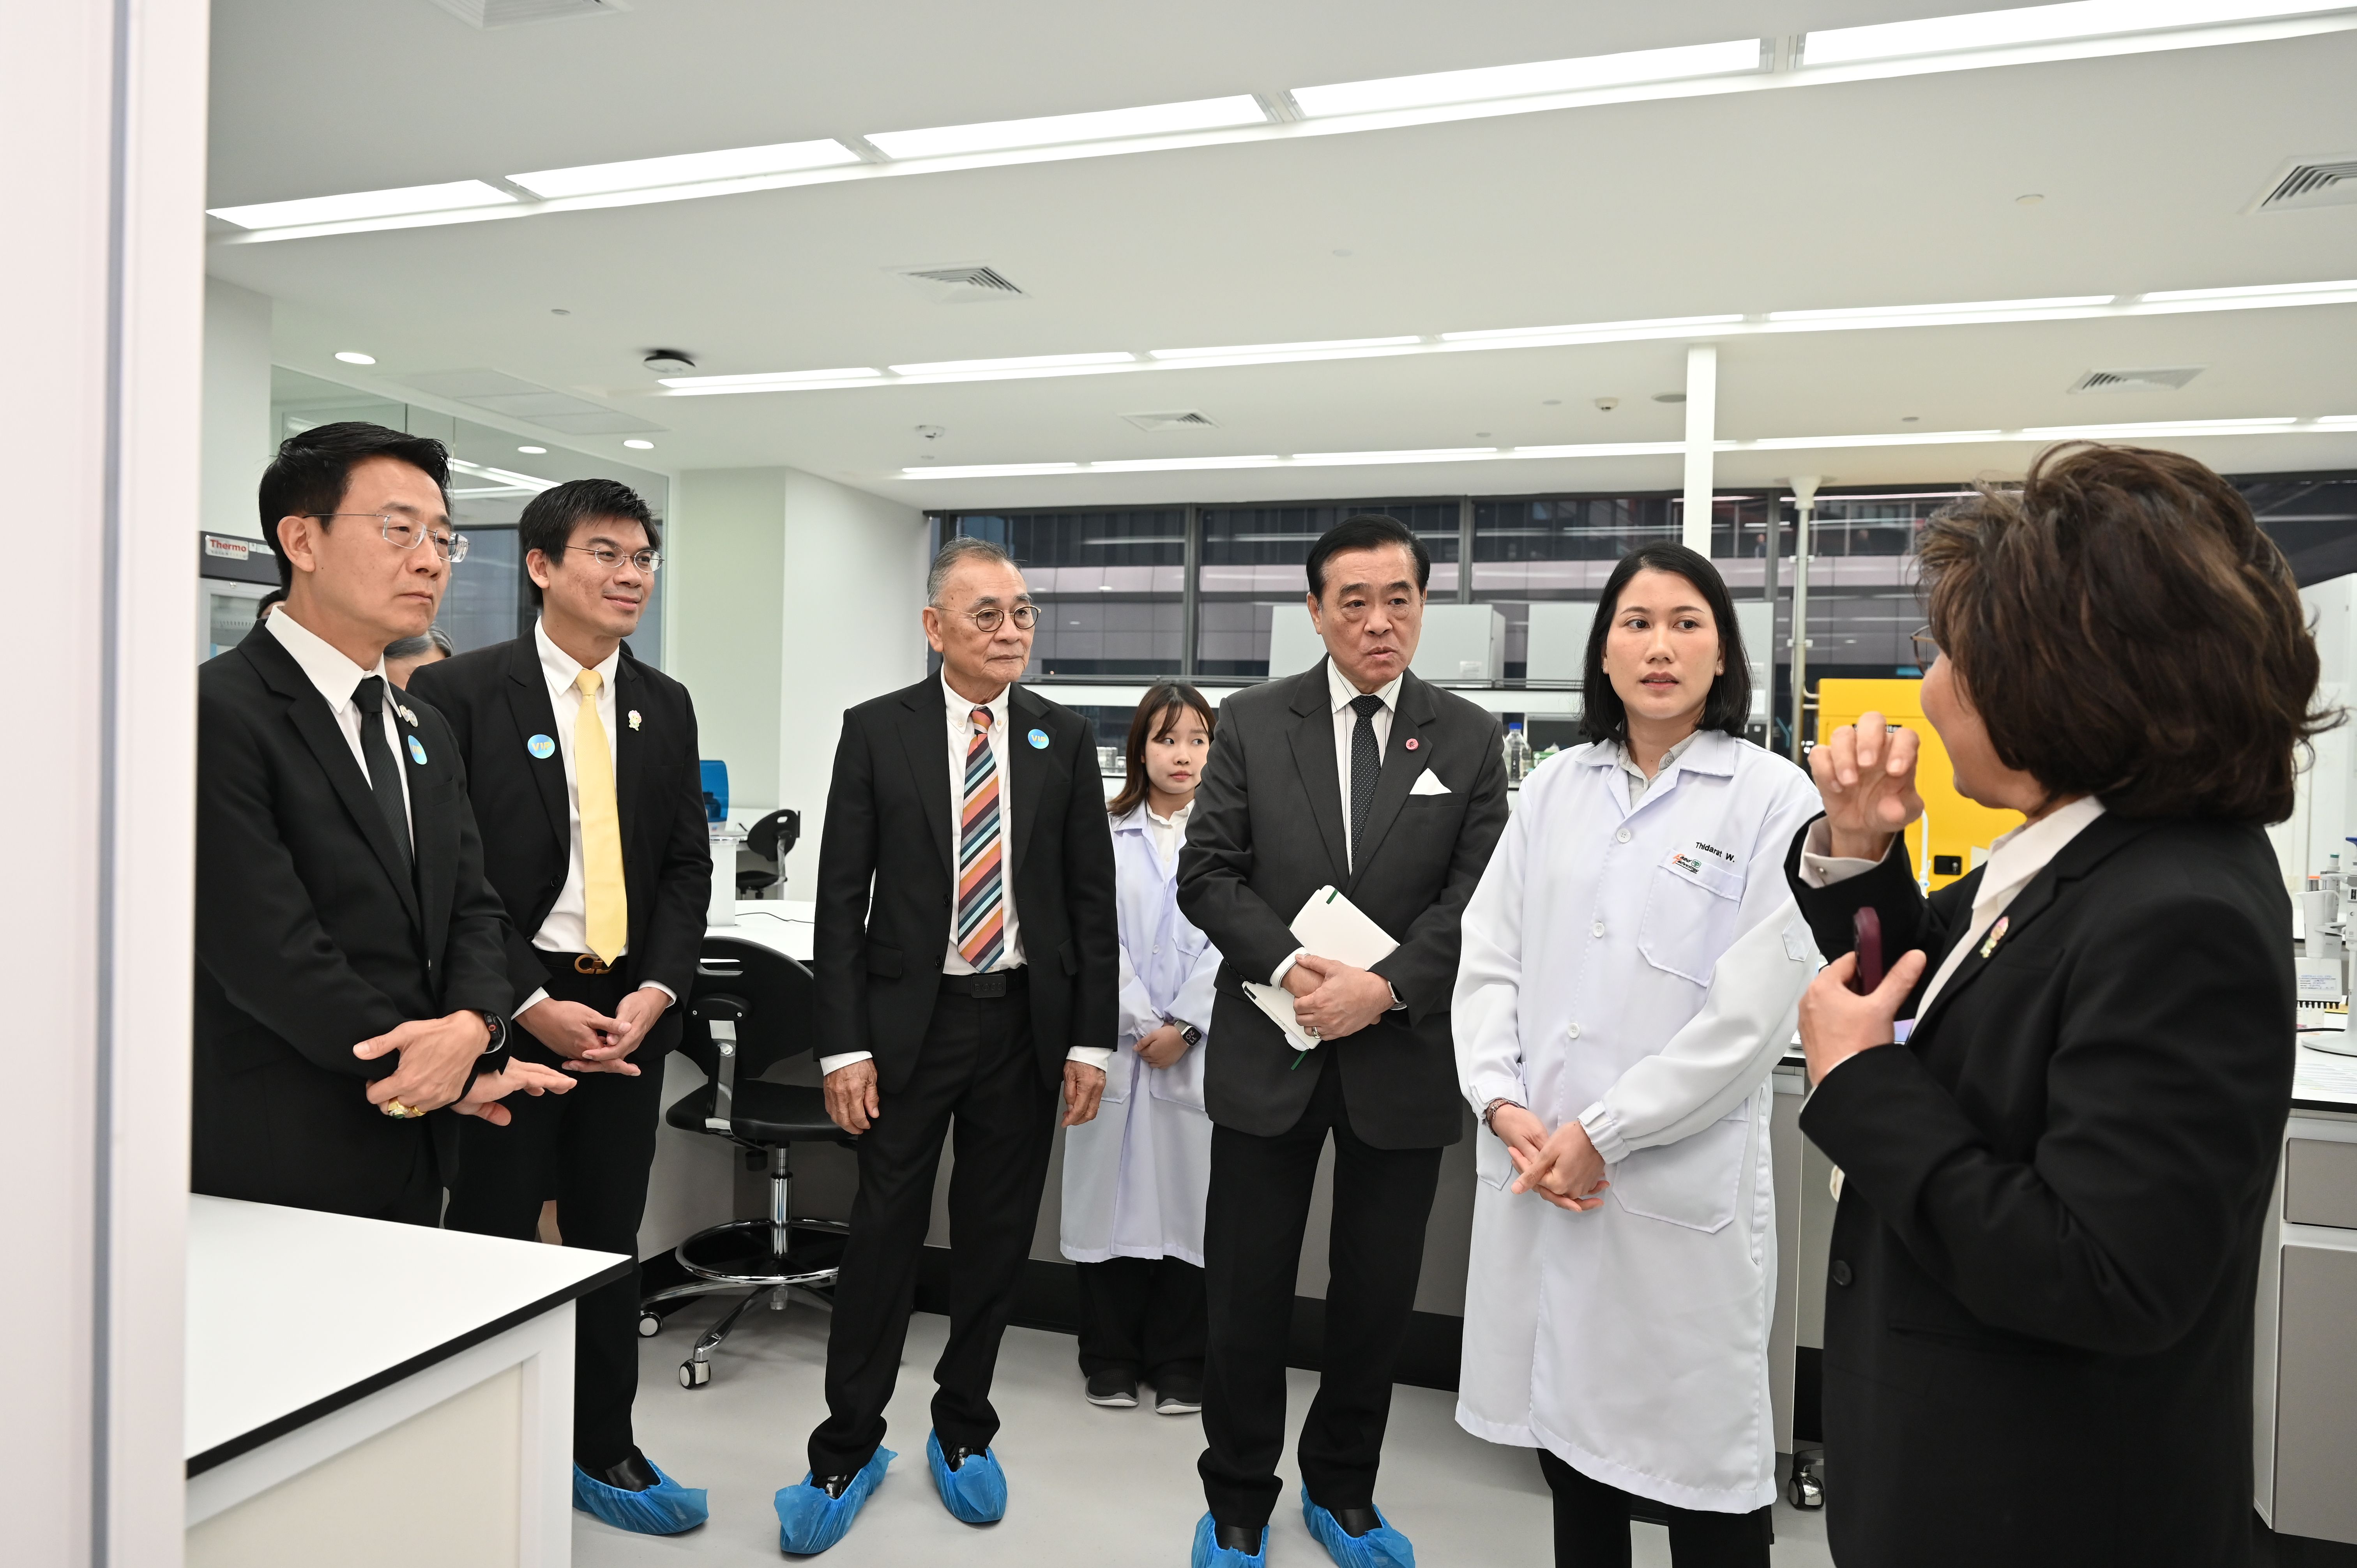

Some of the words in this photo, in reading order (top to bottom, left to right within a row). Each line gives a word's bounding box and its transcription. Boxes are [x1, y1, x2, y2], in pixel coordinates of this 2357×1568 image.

[210, 539, 246, 552] Thermo
[1031, 735, 1047, 743] VIP
[532, 742, 551, 751] VIP
[1696, 842, 1722, 857] Thidarat
[1726, 853, 1735, 862] W.
